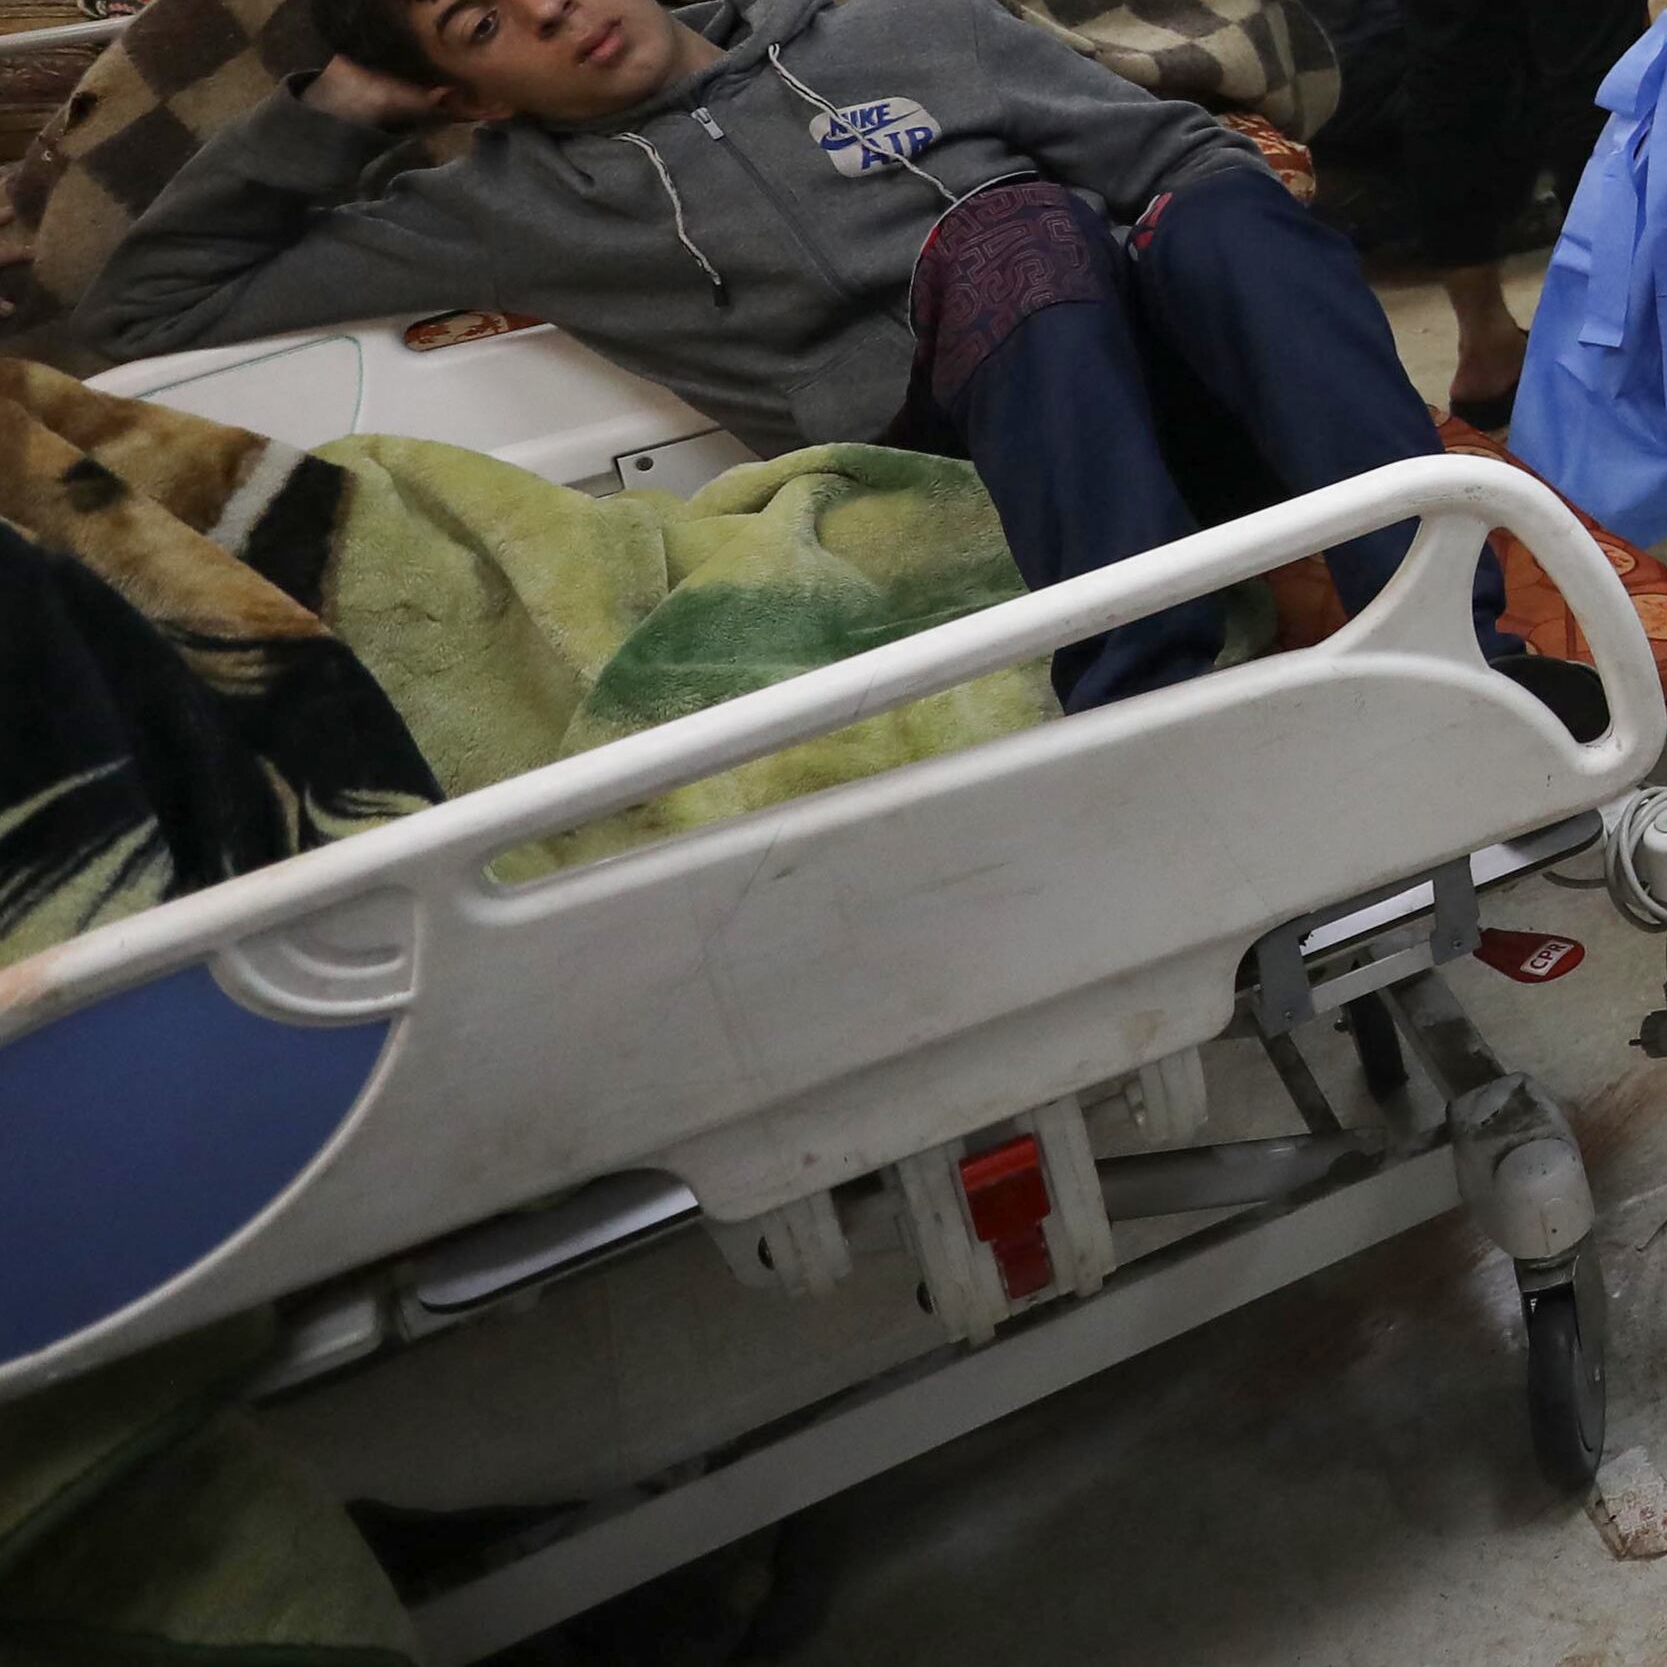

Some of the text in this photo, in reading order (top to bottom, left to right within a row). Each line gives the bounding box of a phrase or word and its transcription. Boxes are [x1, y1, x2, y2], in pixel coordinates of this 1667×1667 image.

[829, 102, 891, 137] NIKE
[861, 126, 934, 171] AIR
[1529, 943, 1567, 970] CPR
